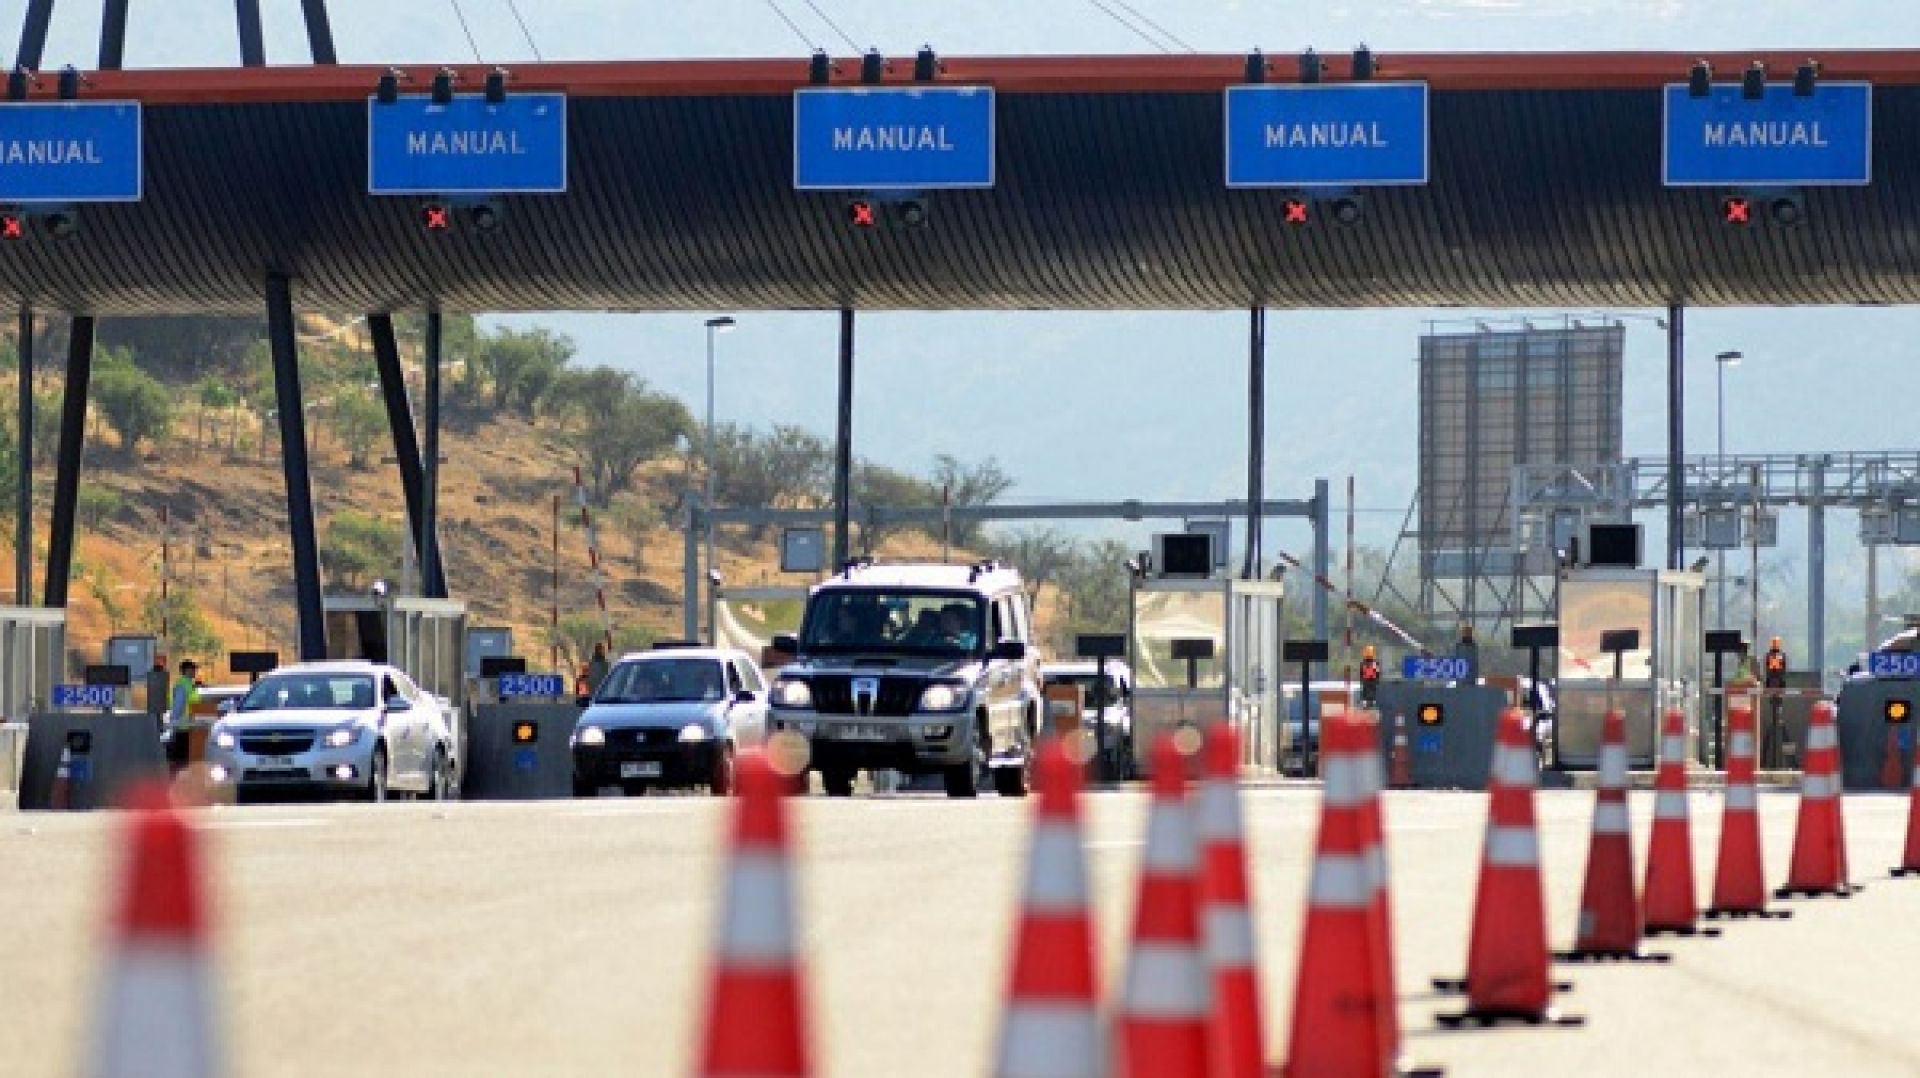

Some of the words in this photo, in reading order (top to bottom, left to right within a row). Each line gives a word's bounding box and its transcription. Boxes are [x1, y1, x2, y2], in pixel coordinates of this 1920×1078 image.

[407, 131, 525, 155] MANUAL
[833, 125, 954, 151] MANUAL
[1265, 122, 1387, 148] MANUAL
[1705, 122, 1828, 148] MANUAL
[0, 141, 101, 165] ANUAL
[1413, 658, 1468, 679] 2500
[63, 688, 114, 705] 2500
[502, 677, 555, 695] 2500
